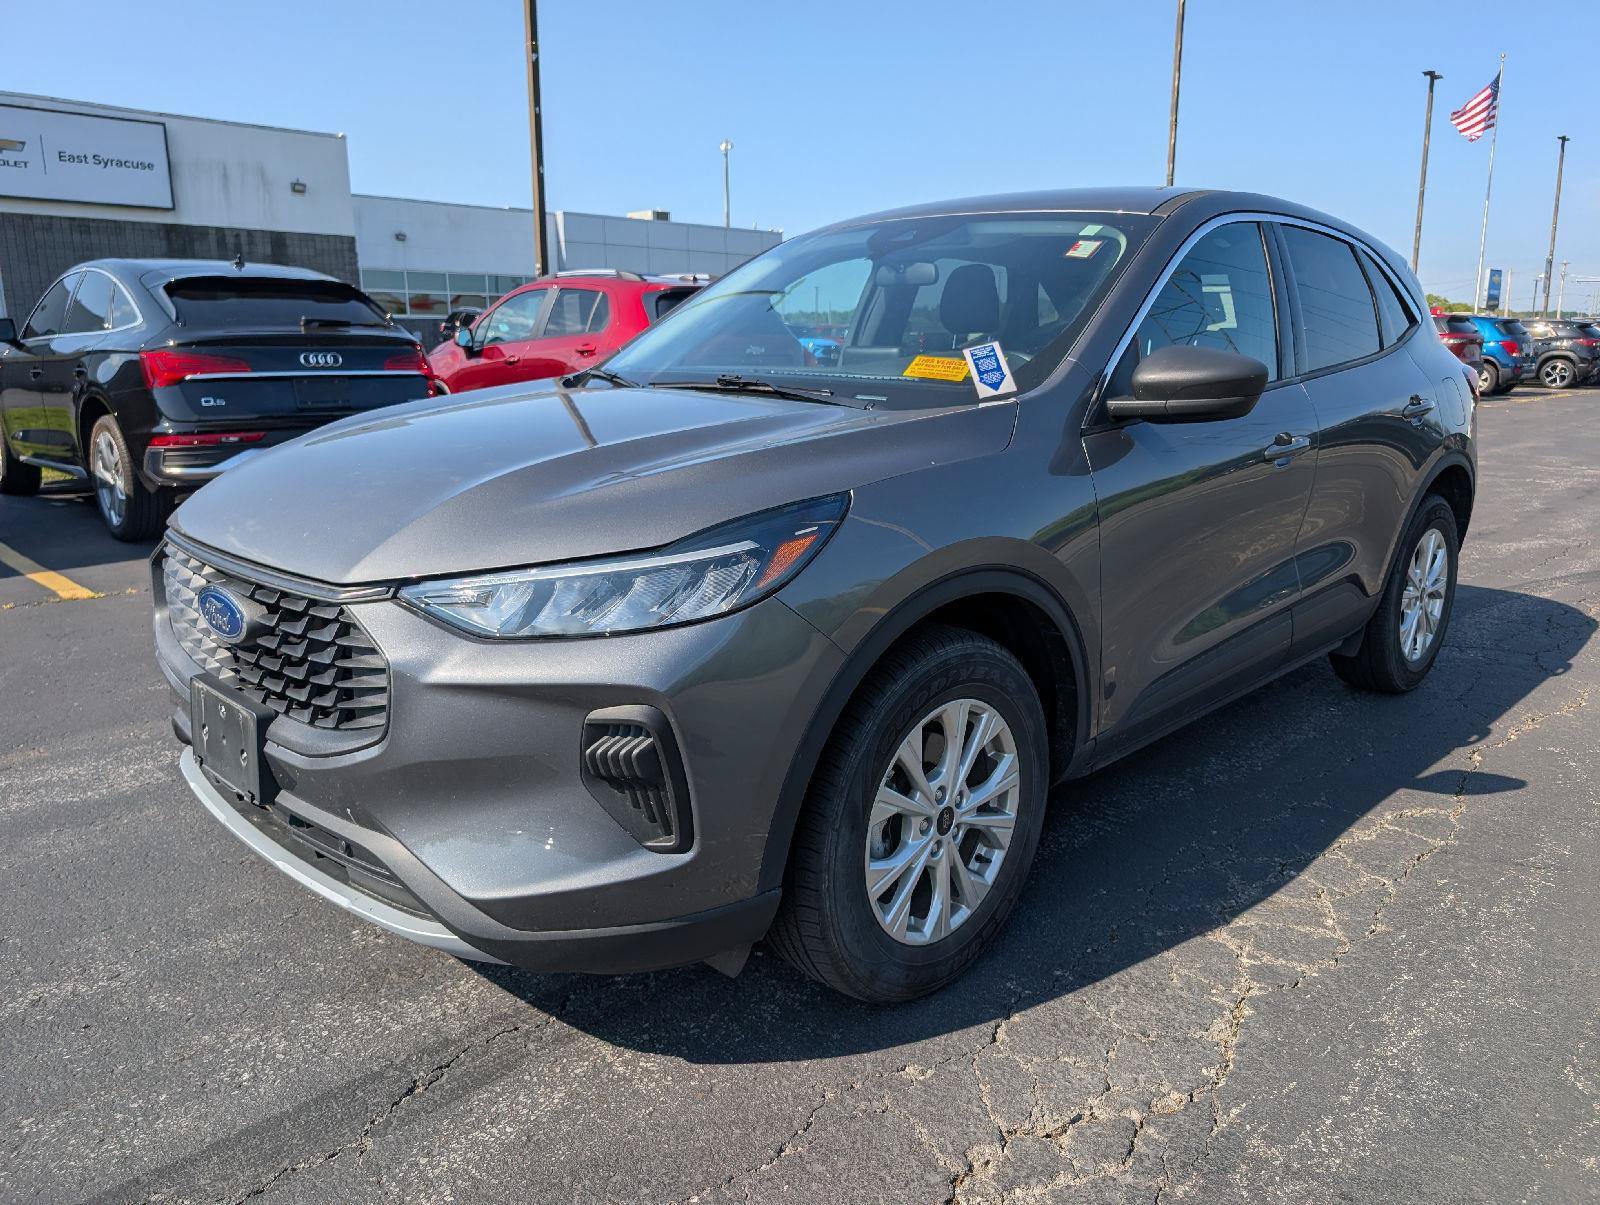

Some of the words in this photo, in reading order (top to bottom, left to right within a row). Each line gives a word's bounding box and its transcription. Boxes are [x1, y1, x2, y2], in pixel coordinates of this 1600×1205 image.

[58, 151, 89, 165] East
[93, 154, 155, 171] Syracuse
[204, 597, 230, 631] Ford
